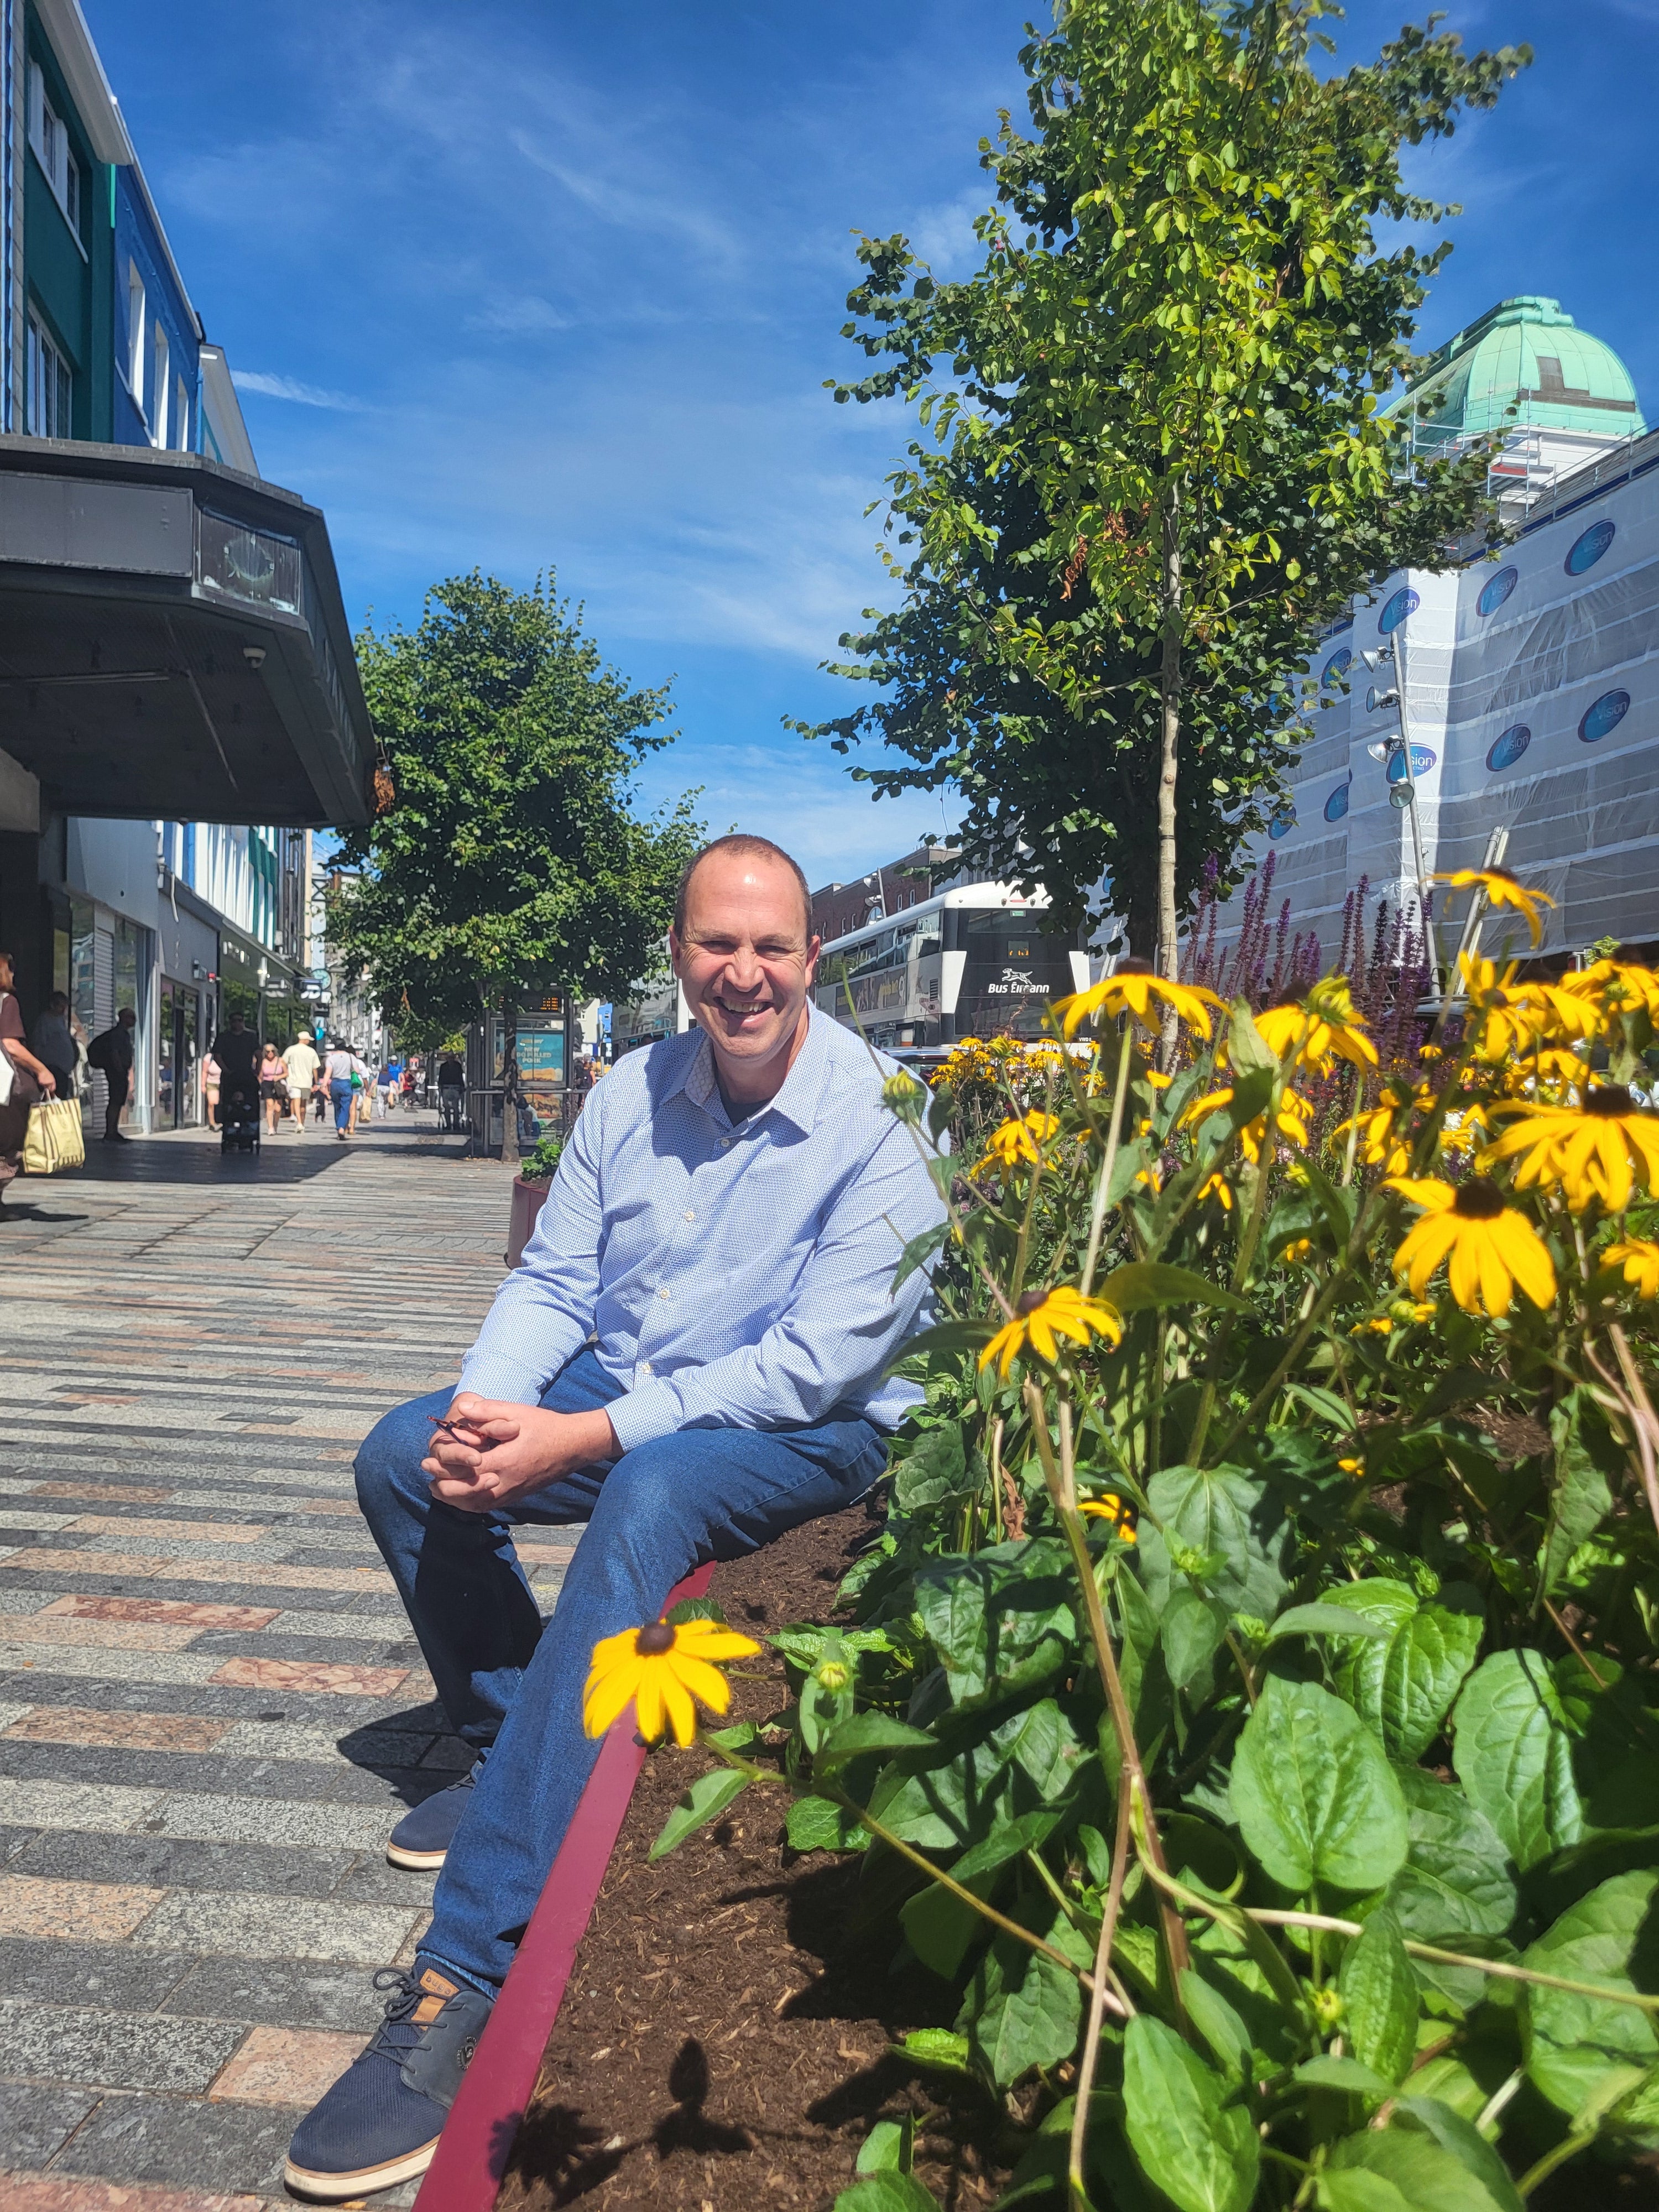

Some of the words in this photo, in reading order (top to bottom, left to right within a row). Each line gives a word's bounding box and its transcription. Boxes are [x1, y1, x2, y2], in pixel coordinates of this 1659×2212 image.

[1389, 598, 1417, 615] Vision
[1596, 701, 1626, 720] Vision
[1501, 735, 1528, 753] Vision
[1411, 754, 1432, 766] sion
[300, 984, 321, 999] JD
[988, 983, 1009, 993] Bus
